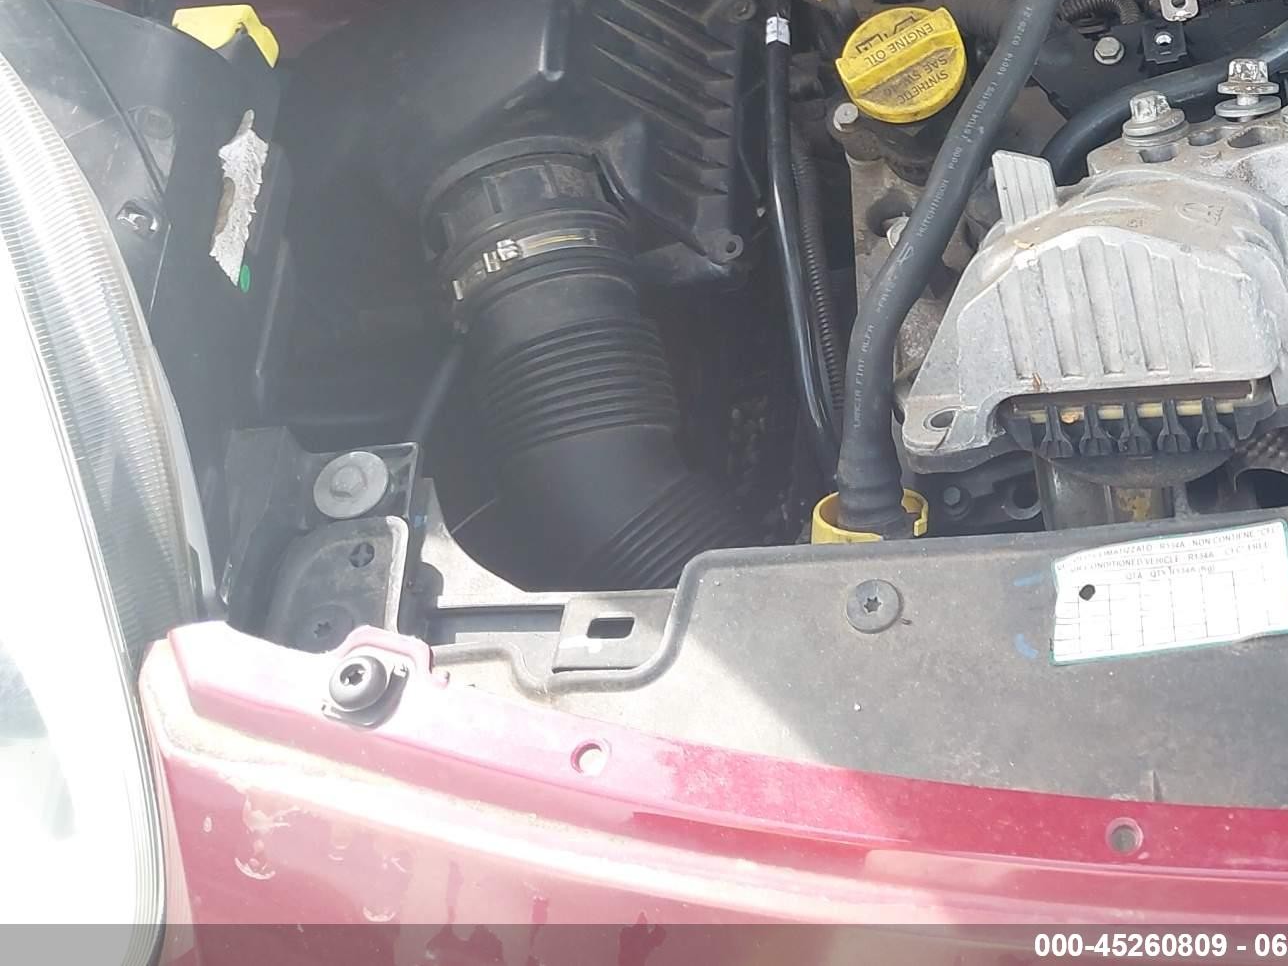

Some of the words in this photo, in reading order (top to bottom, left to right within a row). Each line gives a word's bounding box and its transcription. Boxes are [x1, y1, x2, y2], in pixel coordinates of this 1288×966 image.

[888, 22, 934, 55] ENGINE
[864, 49, 888, 68] OIL
[922, 54, 950, 76] SAE
[896, 68, 950, 106] SYNTHETIC
